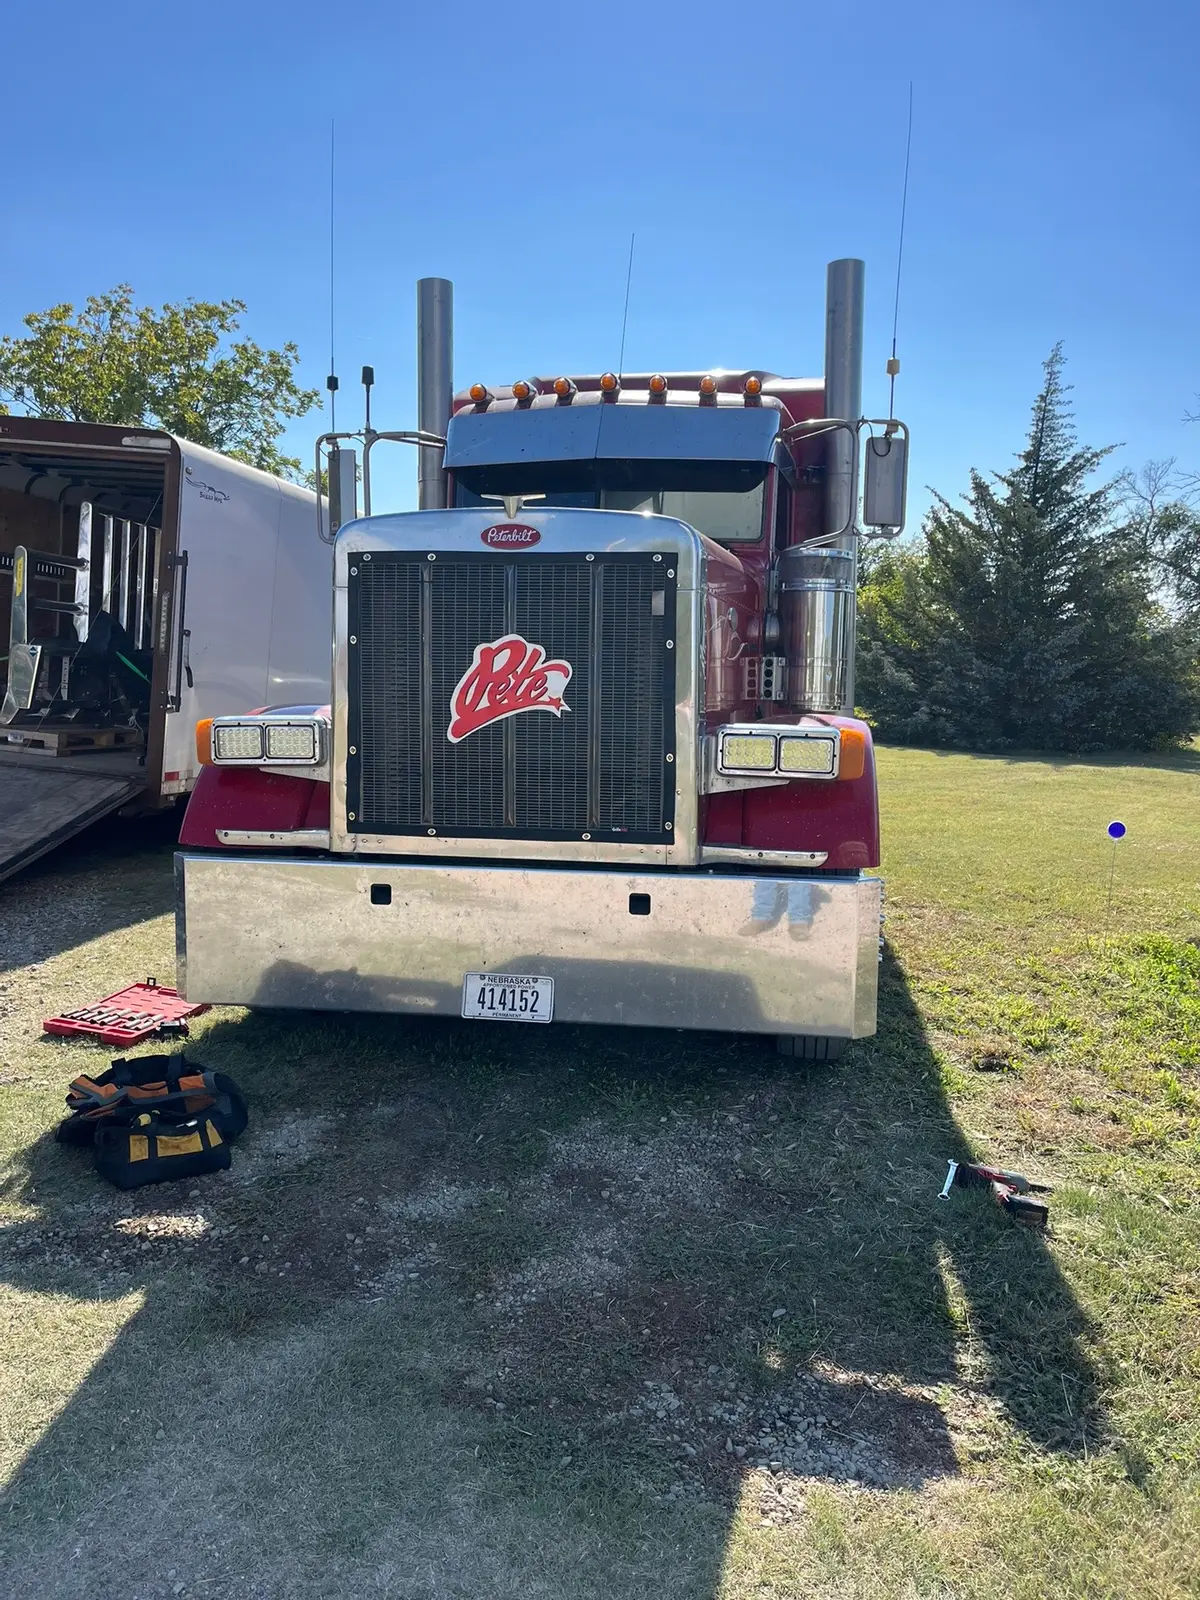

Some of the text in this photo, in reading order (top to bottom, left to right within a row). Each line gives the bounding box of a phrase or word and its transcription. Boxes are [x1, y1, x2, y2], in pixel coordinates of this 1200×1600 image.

[487, 527, 537, 543] Peterbilt
[450, 639, 570, 738] Pete
[487, 976, 531, 985] NEBRASKA
[477, 987, 539, 1013] 414152
